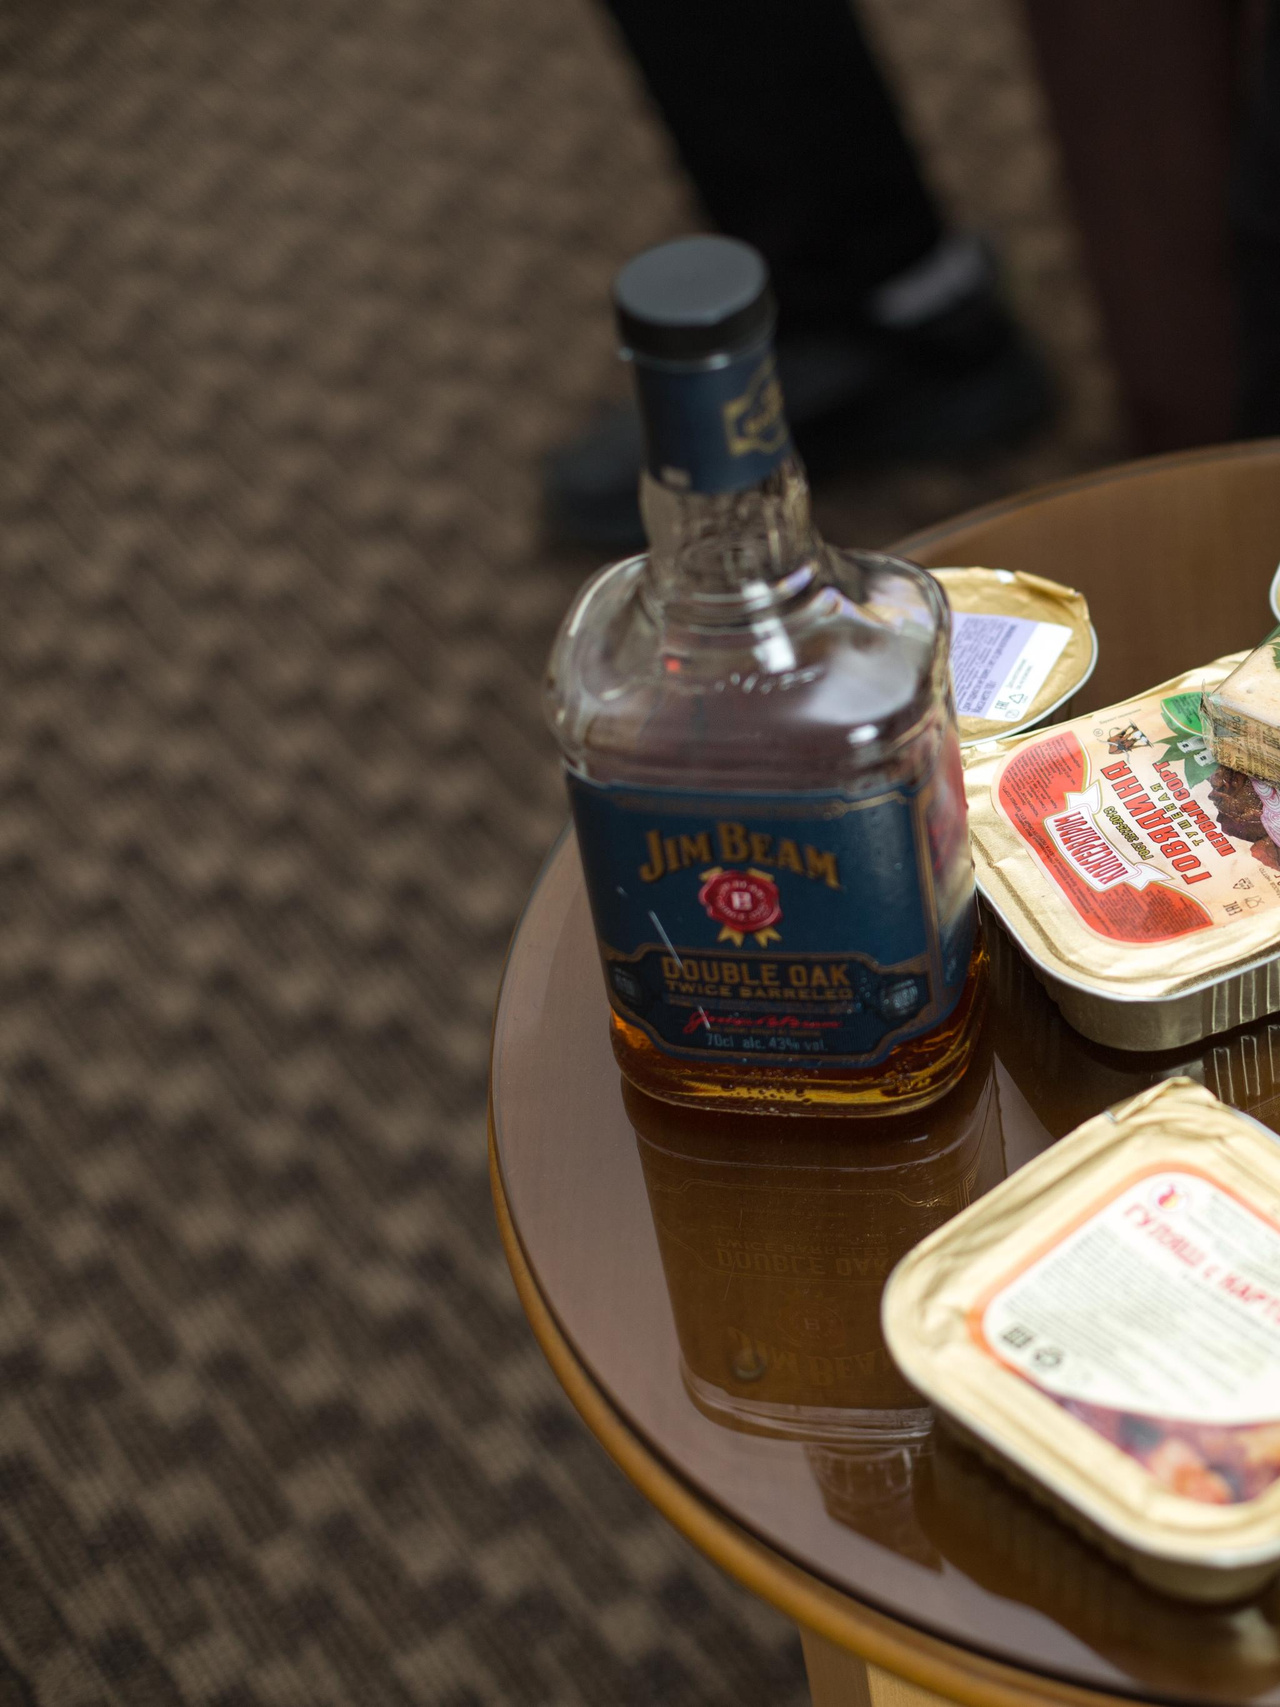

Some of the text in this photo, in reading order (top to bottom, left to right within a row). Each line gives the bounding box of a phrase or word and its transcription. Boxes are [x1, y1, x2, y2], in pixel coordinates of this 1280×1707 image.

[1153, 761, 1191, 801] СОРТ
[1100, 760, 1212, 885] ГОВЯДИНА
[1150, 783, 1204, 846] ТУШЕНАЯ
[1180, 799, 1236, 857] ПЕРВЫЙ
[639, 821, 842, 891] JIM BEAM
[1053, 811, 1129, 885] КОНСЕРВПРОМ
[1132, 836, 1154, 860] ГОСТ
[661, 956, 851, 987] DOUBLE OAK
[665, 979, 854, 999] TWICE BARRELED
[706, 1033, 734, 1049] 70cl
[769, 1034, 800, 1050] 43%
